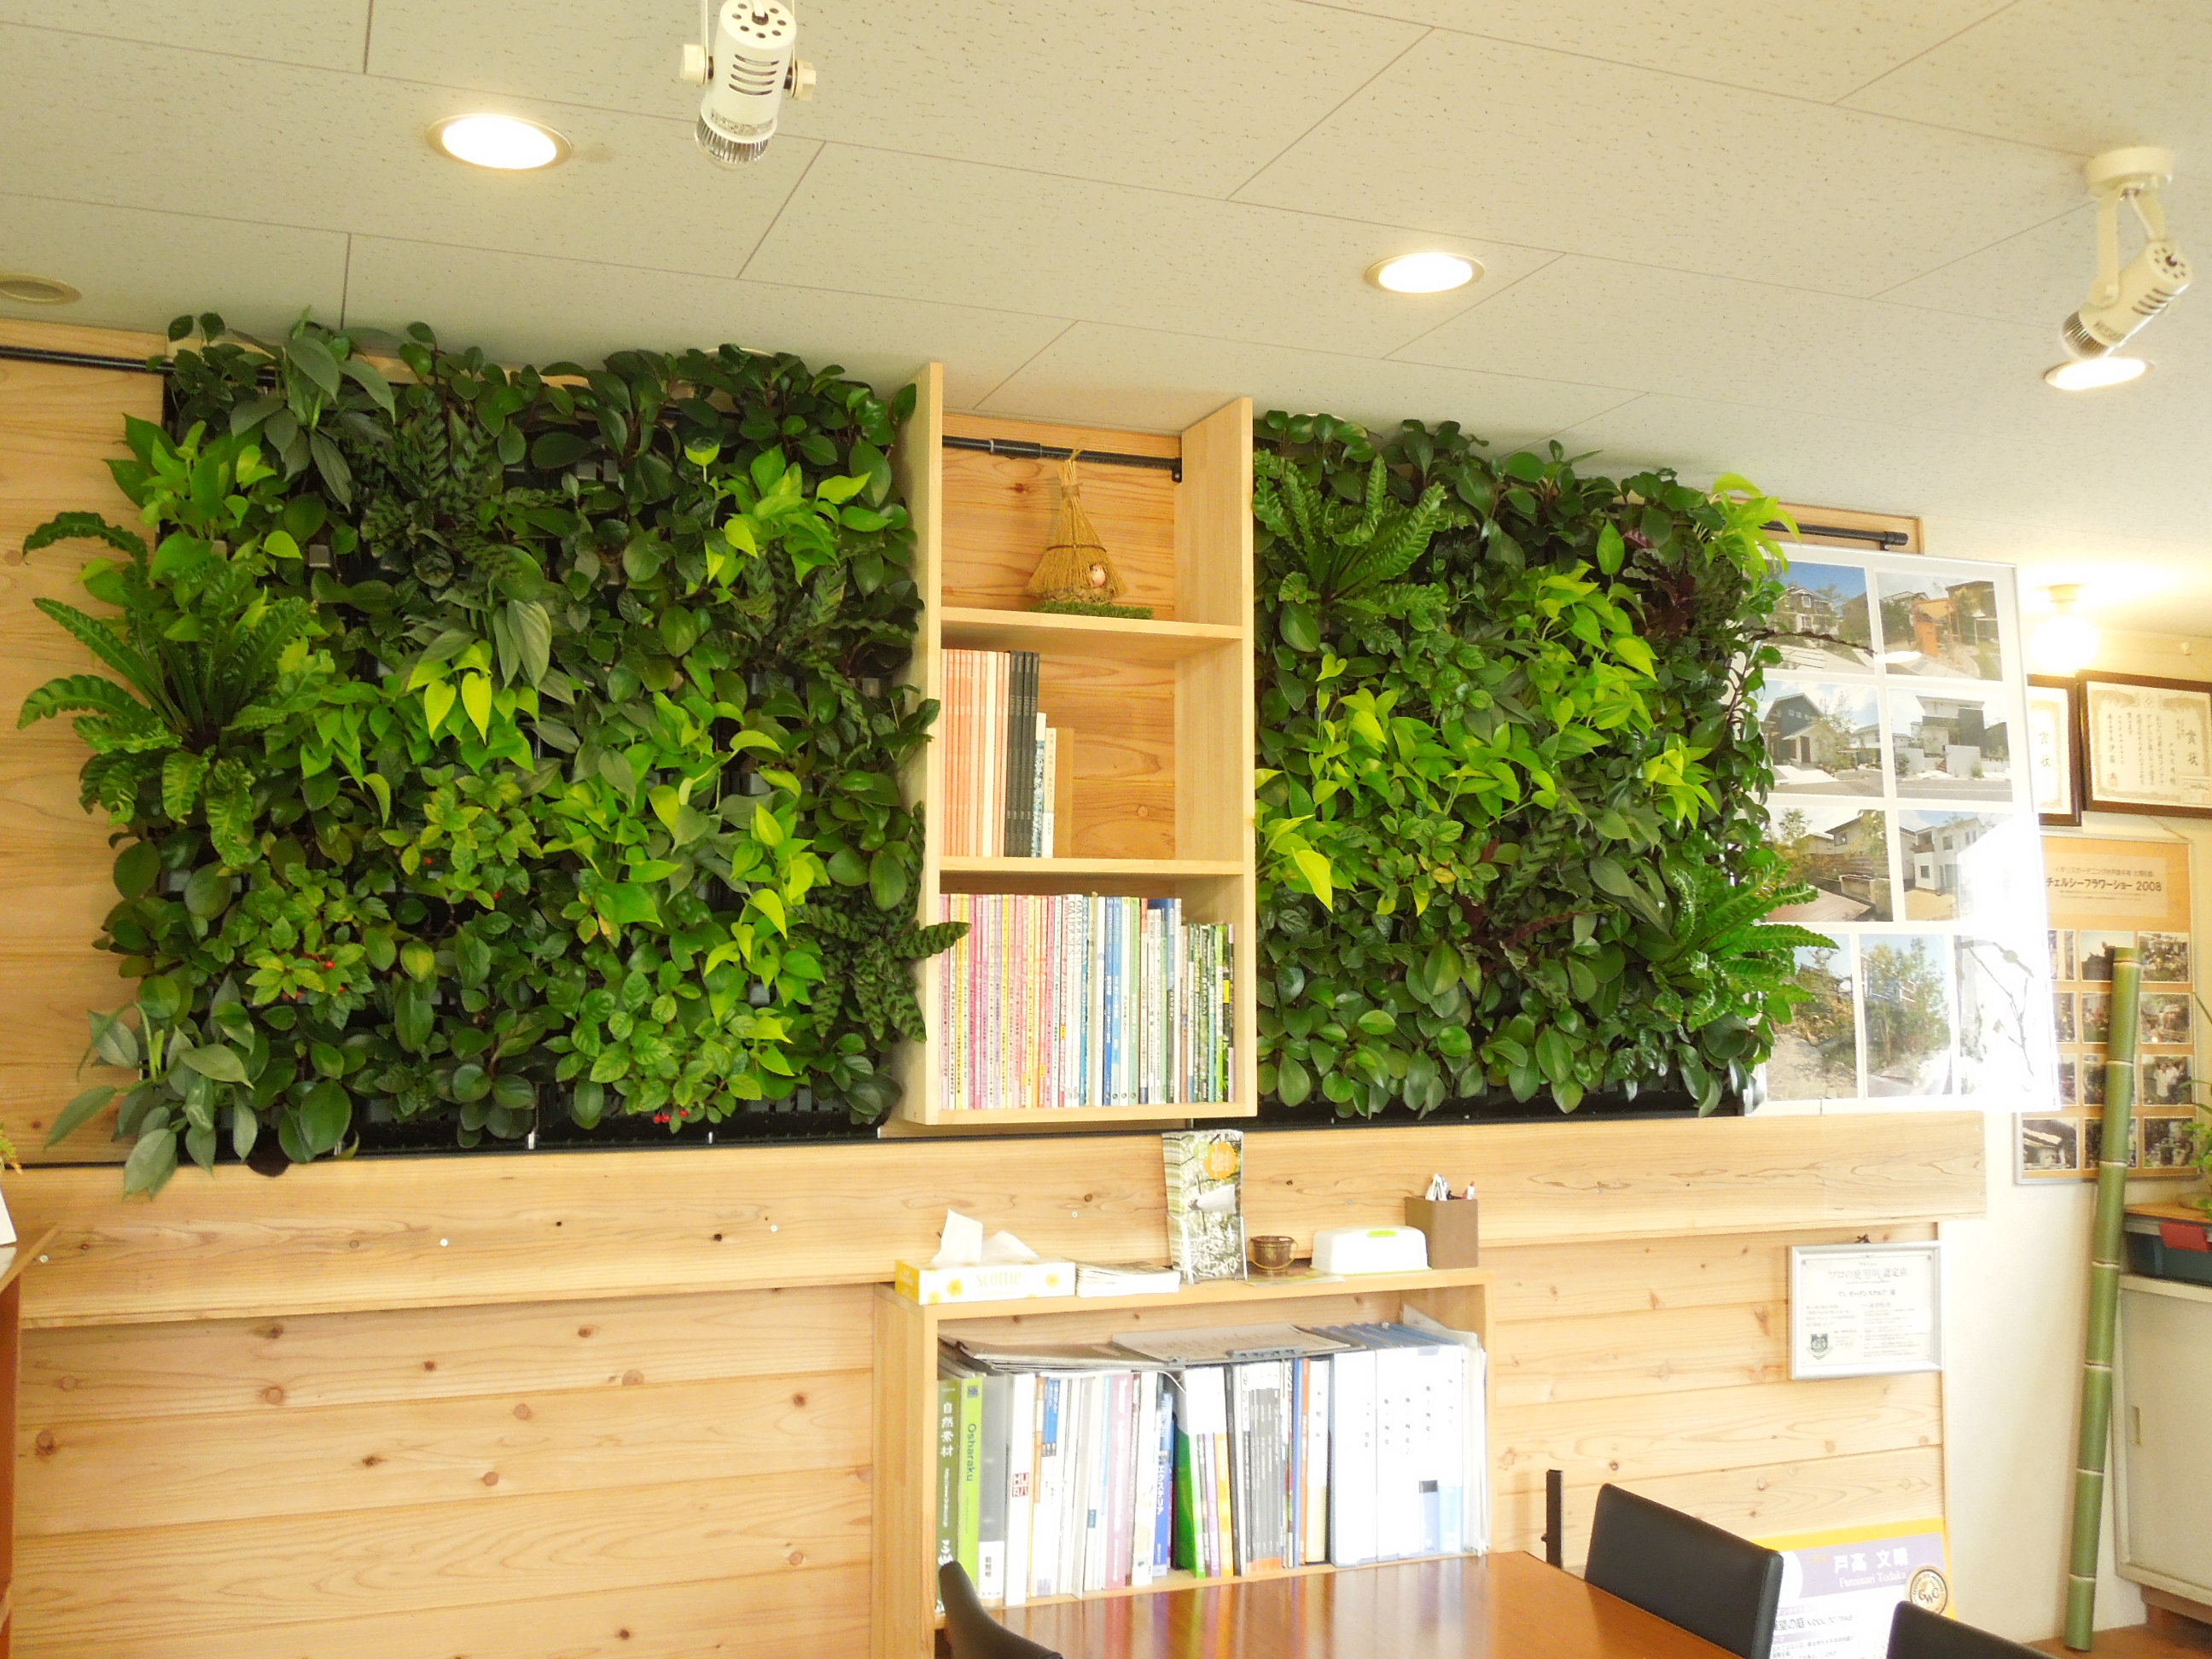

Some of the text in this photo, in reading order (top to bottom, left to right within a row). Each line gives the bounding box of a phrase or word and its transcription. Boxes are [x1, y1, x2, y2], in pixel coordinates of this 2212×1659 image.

[2046, 876, 2163, 892] チェルシーフラワーショー 2008
[976, 1270, 1022, 1287] scottie
[940, 1401, 954, 1458] 自然素材
[966, 1423, 978, 1482] Osharaku
